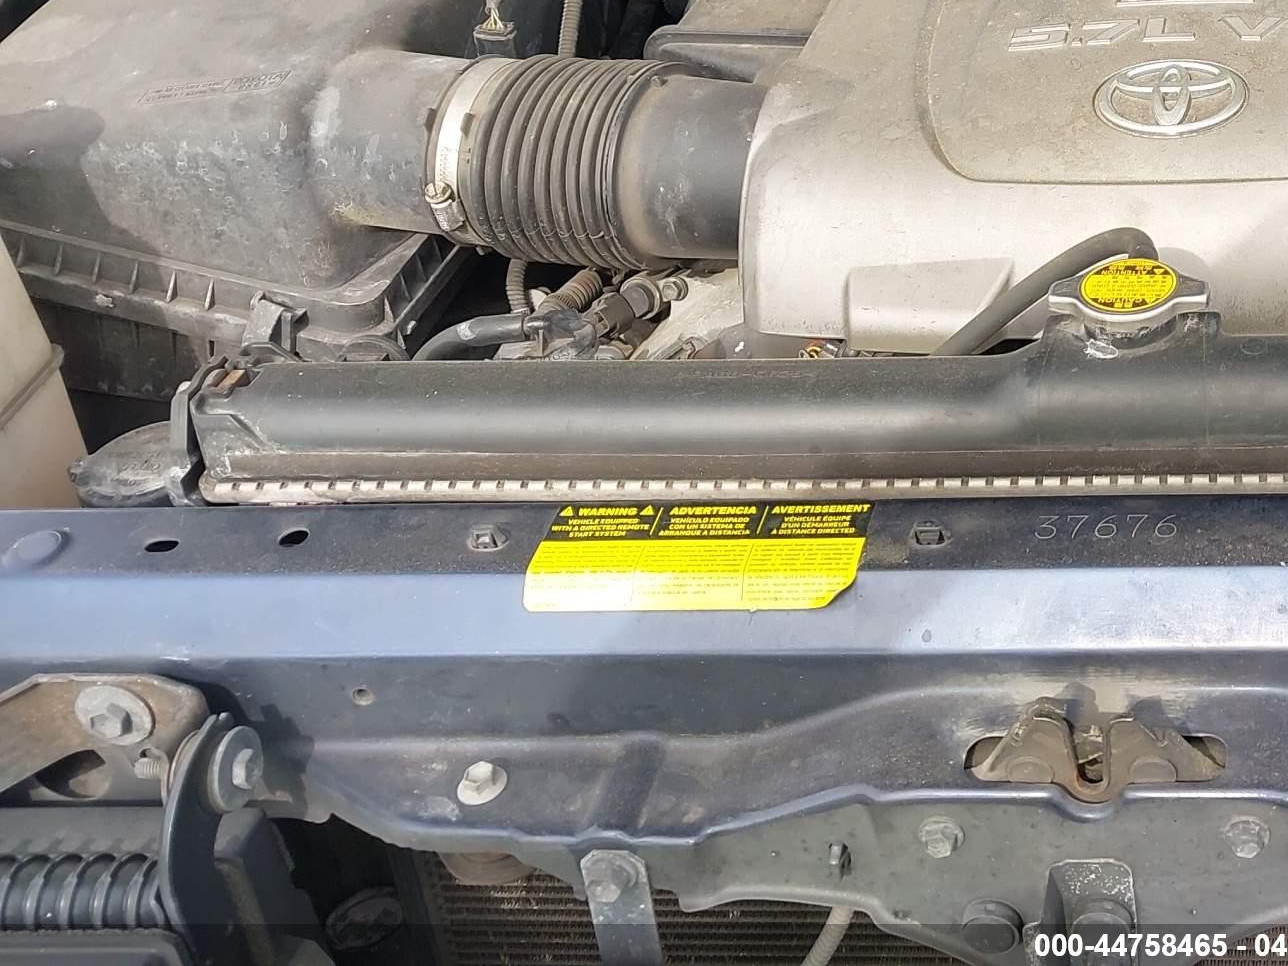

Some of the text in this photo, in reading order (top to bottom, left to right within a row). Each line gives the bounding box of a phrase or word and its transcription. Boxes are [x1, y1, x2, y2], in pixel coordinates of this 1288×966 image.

[1007, 16, 1196, 51] 5.7L
[578, 507, 638, 516] WARNING
[669, 506, 757, 516] ADVERTENCIA
[771, 504, 871, 514] AVERTISSEMENT
[1034, 514, 1178, 539] 37676
